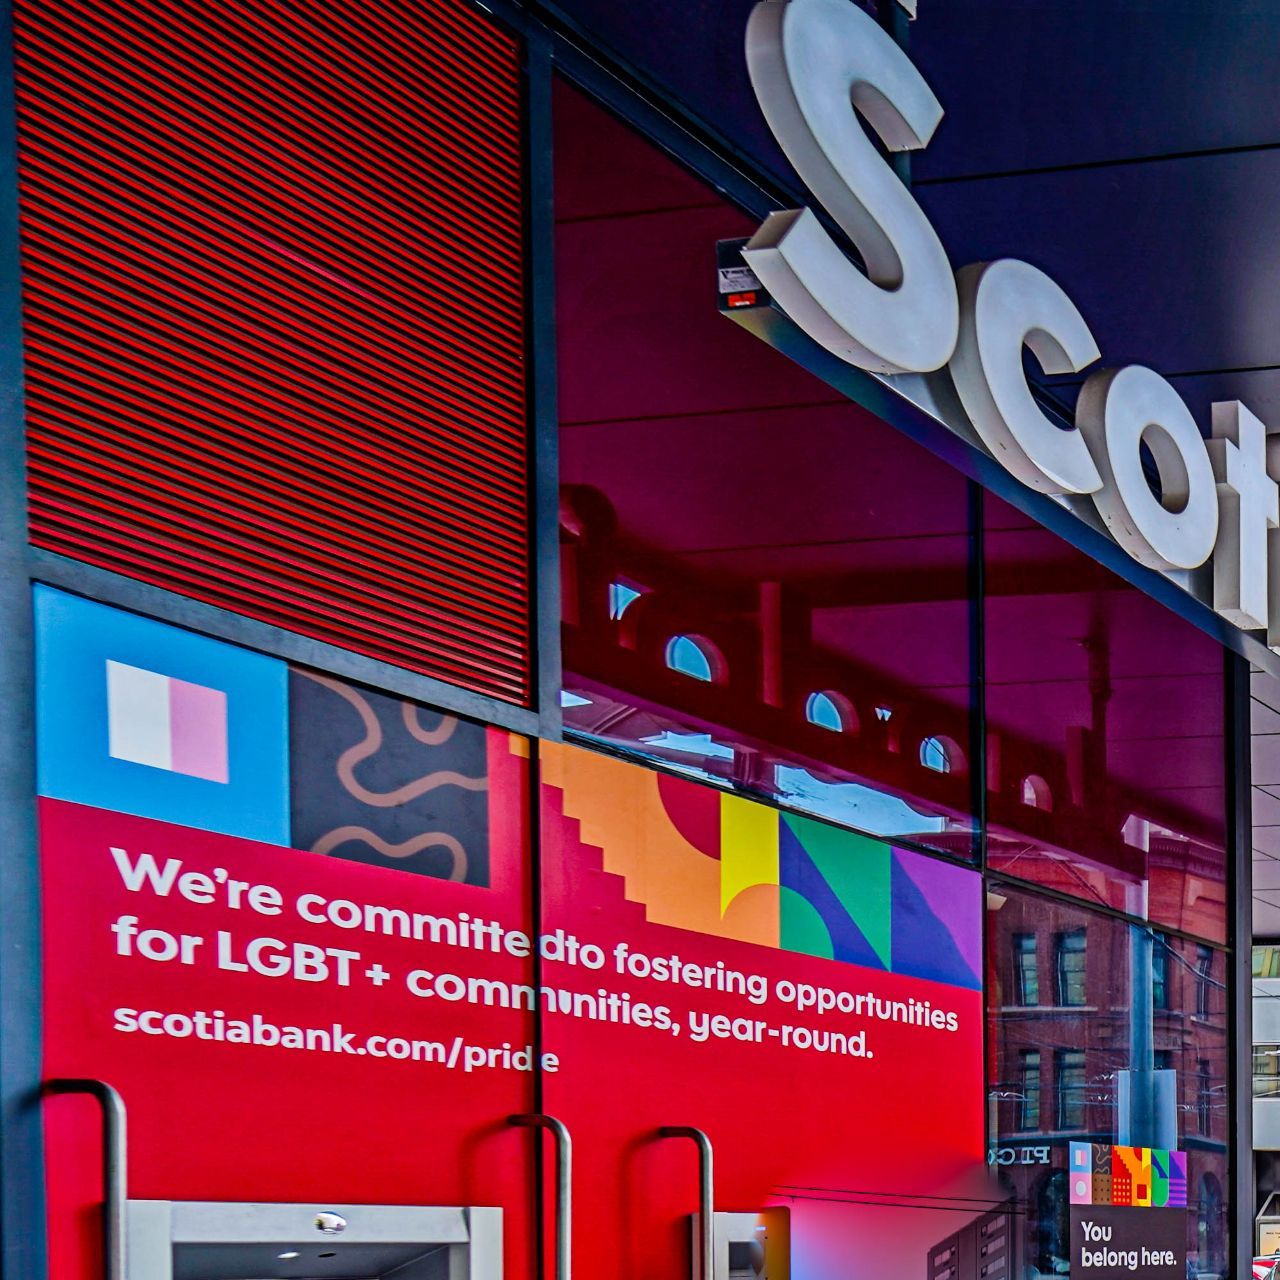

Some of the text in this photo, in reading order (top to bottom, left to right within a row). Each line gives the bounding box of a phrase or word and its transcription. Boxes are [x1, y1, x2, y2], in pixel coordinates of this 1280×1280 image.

[110, 847, 959, 1032] We're committed to fostering opportunities
[111, 914, 204, 966] for
[688, 1009, 874, 1060] year-round.
[113, 1003, 560, 1073] scotiabank.com/pride
[1081, 1221, 1112, 1242] You
[1081, 1246, 1177, 1271] belong here.
